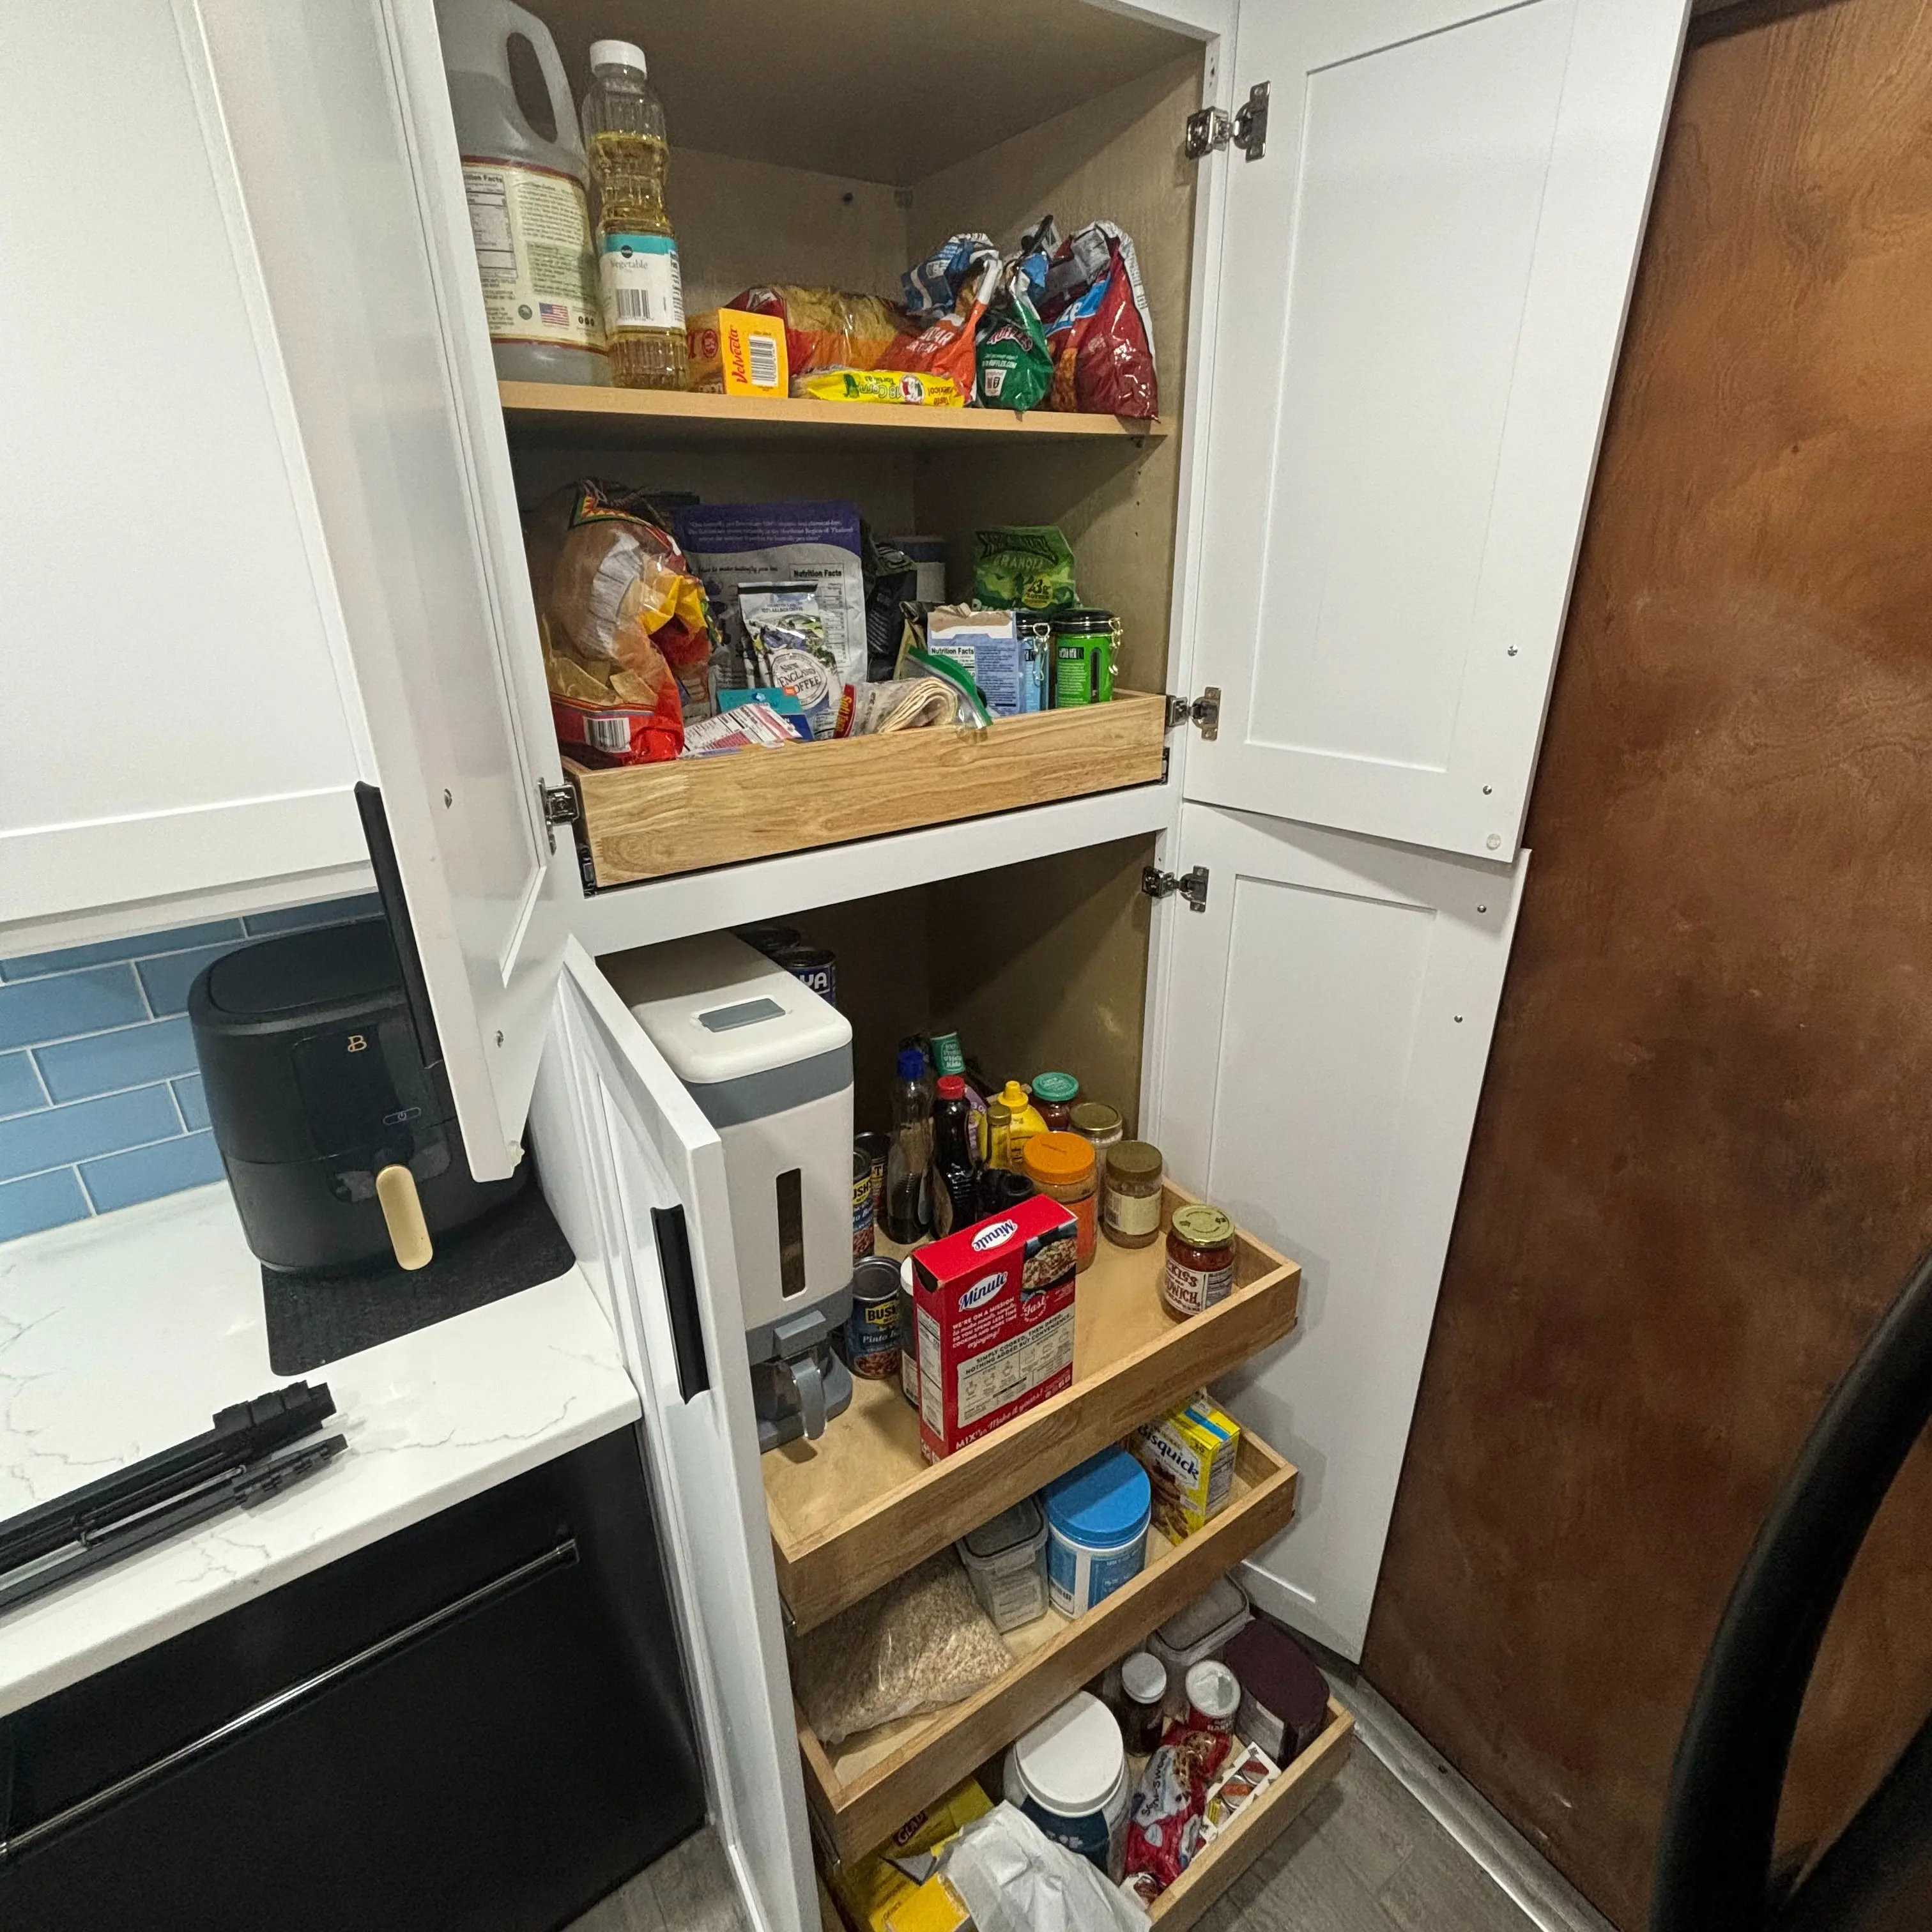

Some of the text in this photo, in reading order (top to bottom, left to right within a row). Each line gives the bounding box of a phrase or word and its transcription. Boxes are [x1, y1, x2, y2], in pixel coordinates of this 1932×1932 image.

[610, 259, 648, 269] Vegetable
[728, 325, 748, 384] Velveeta
[794, 569, 842, 578] Nutrition Facts
[778, 668, 816, 687] ENGLAND
[794, 676, 821, 694] OFFEE
[972, 1220, 1016, 1250] Minute
[960, 1272, 1007, 1310] Minute
[953, 1317, 972, 1330] WE'RE
[972, 1312, 983, 1321] ON
[990, 1297, 1015, 1313] MISSION
[862, 1333, 888, 1343] Pinto
[953, 1333, 977, 1348] COOKING
[978, 1327, 990, 1337] AND
[990, 1320, 1005, 1332] MORE
[962, 1330, 972, 1338] YOU
[974, 1321, 991, 1334] SPEND
[966, 1357, 995, 1374] NOTHING
[997, 1346, 1018, 1359] ADDED
[1019, 1338, 1030, 1347] BUT
[976, 1349, 998, 1363] SIMPLY
[1029, 1326, 1043, 1337] THEN
[1138, 1423, 1199, 1481] Bisquick
